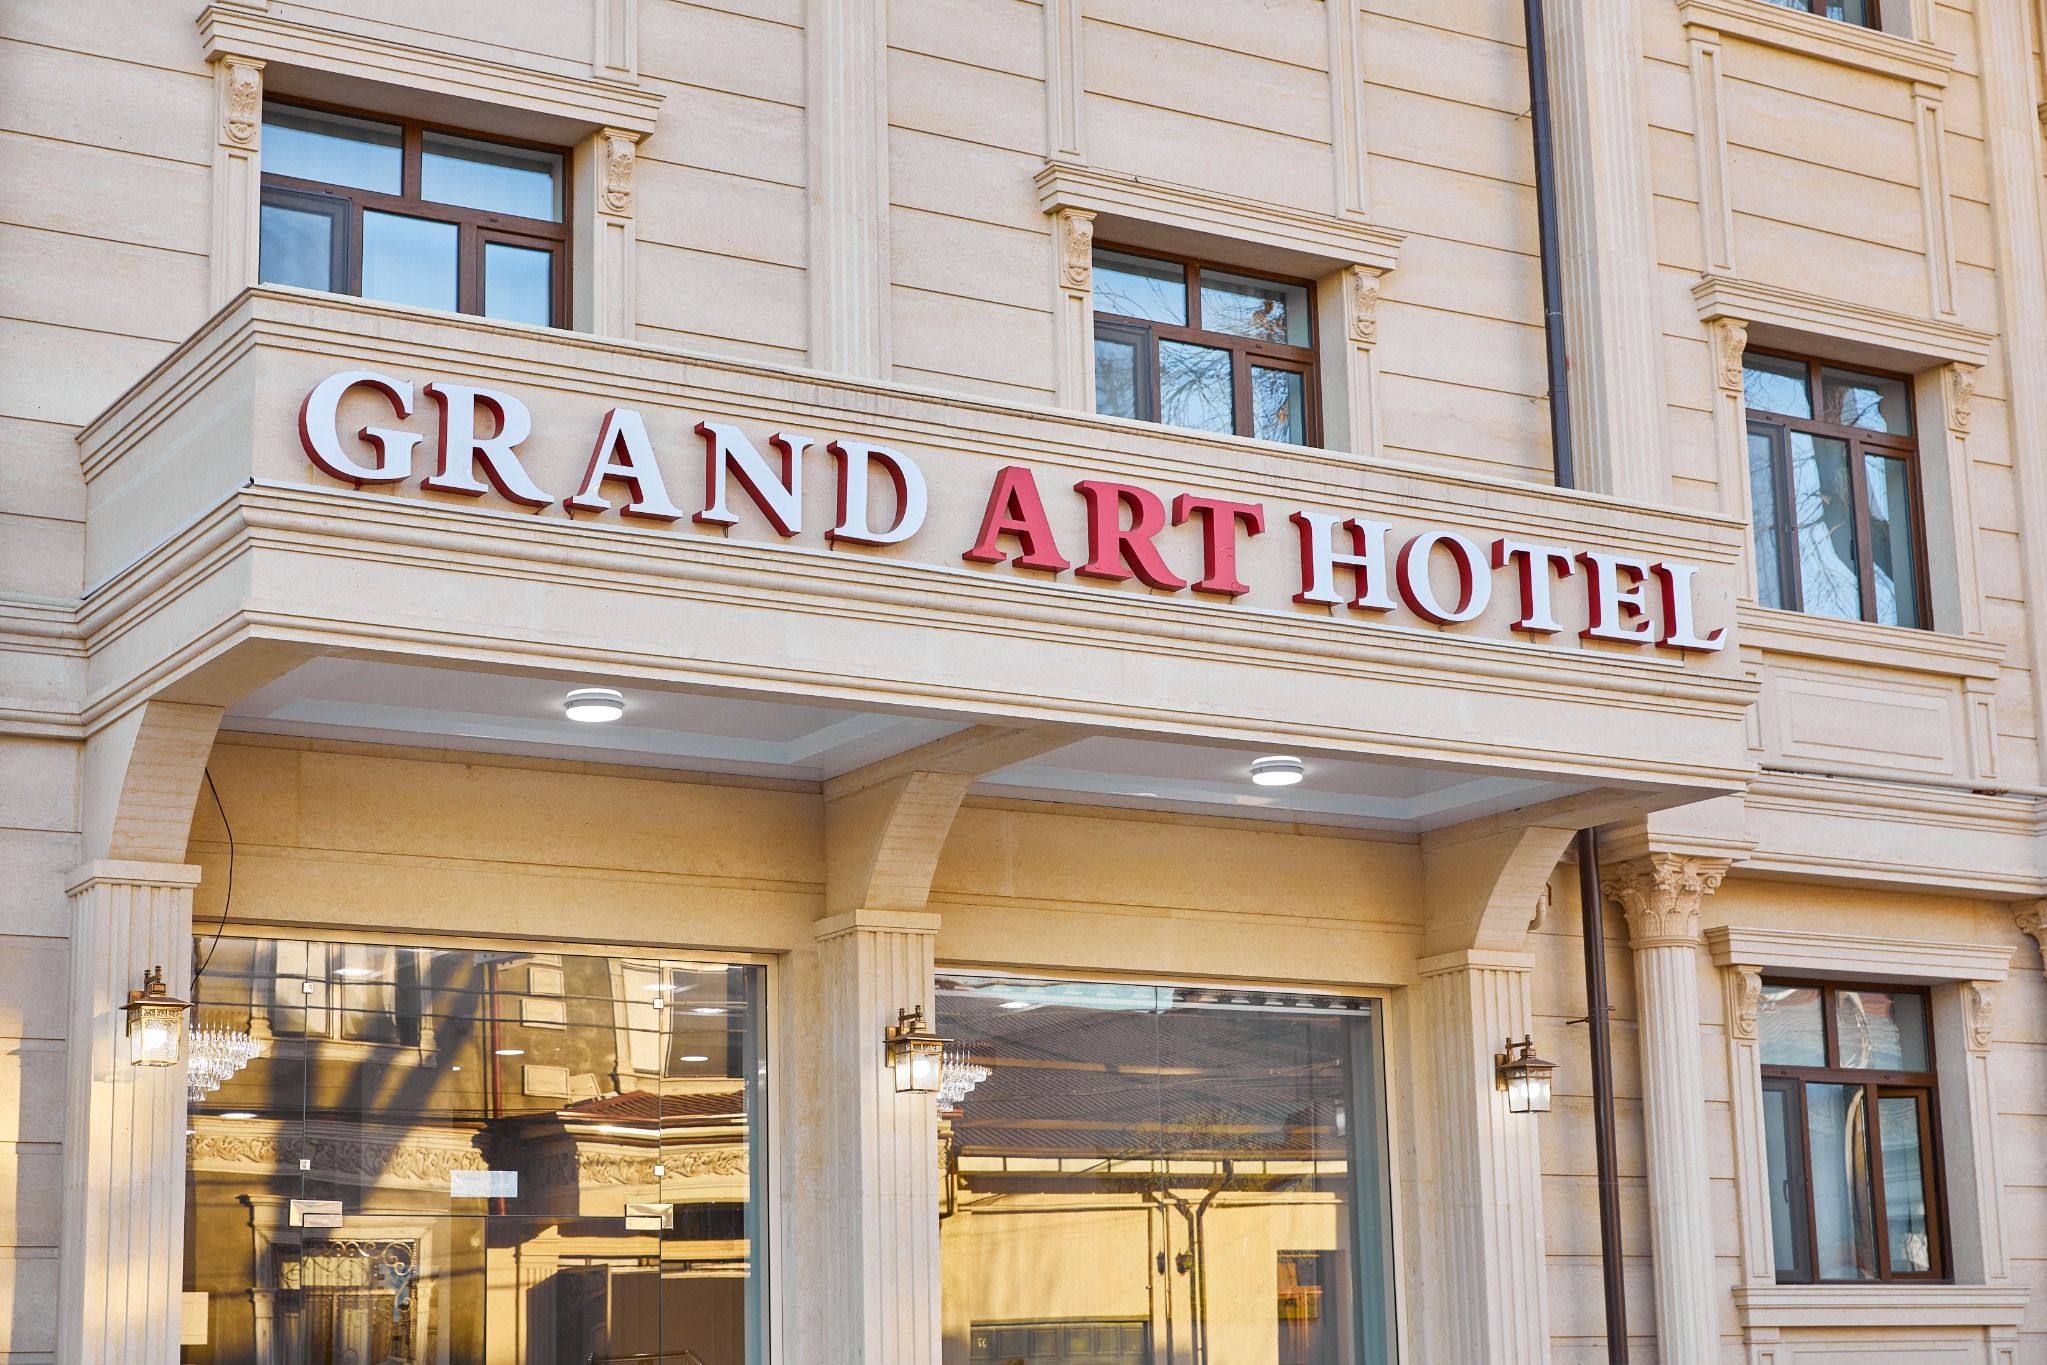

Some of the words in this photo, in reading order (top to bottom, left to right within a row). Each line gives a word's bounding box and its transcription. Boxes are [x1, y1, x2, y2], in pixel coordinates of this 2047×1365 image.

[298, 370, 928, 546] GRAND
[962, 465, 1265, 597] ART
[1288, 510, 1727, 653] HOTEL
